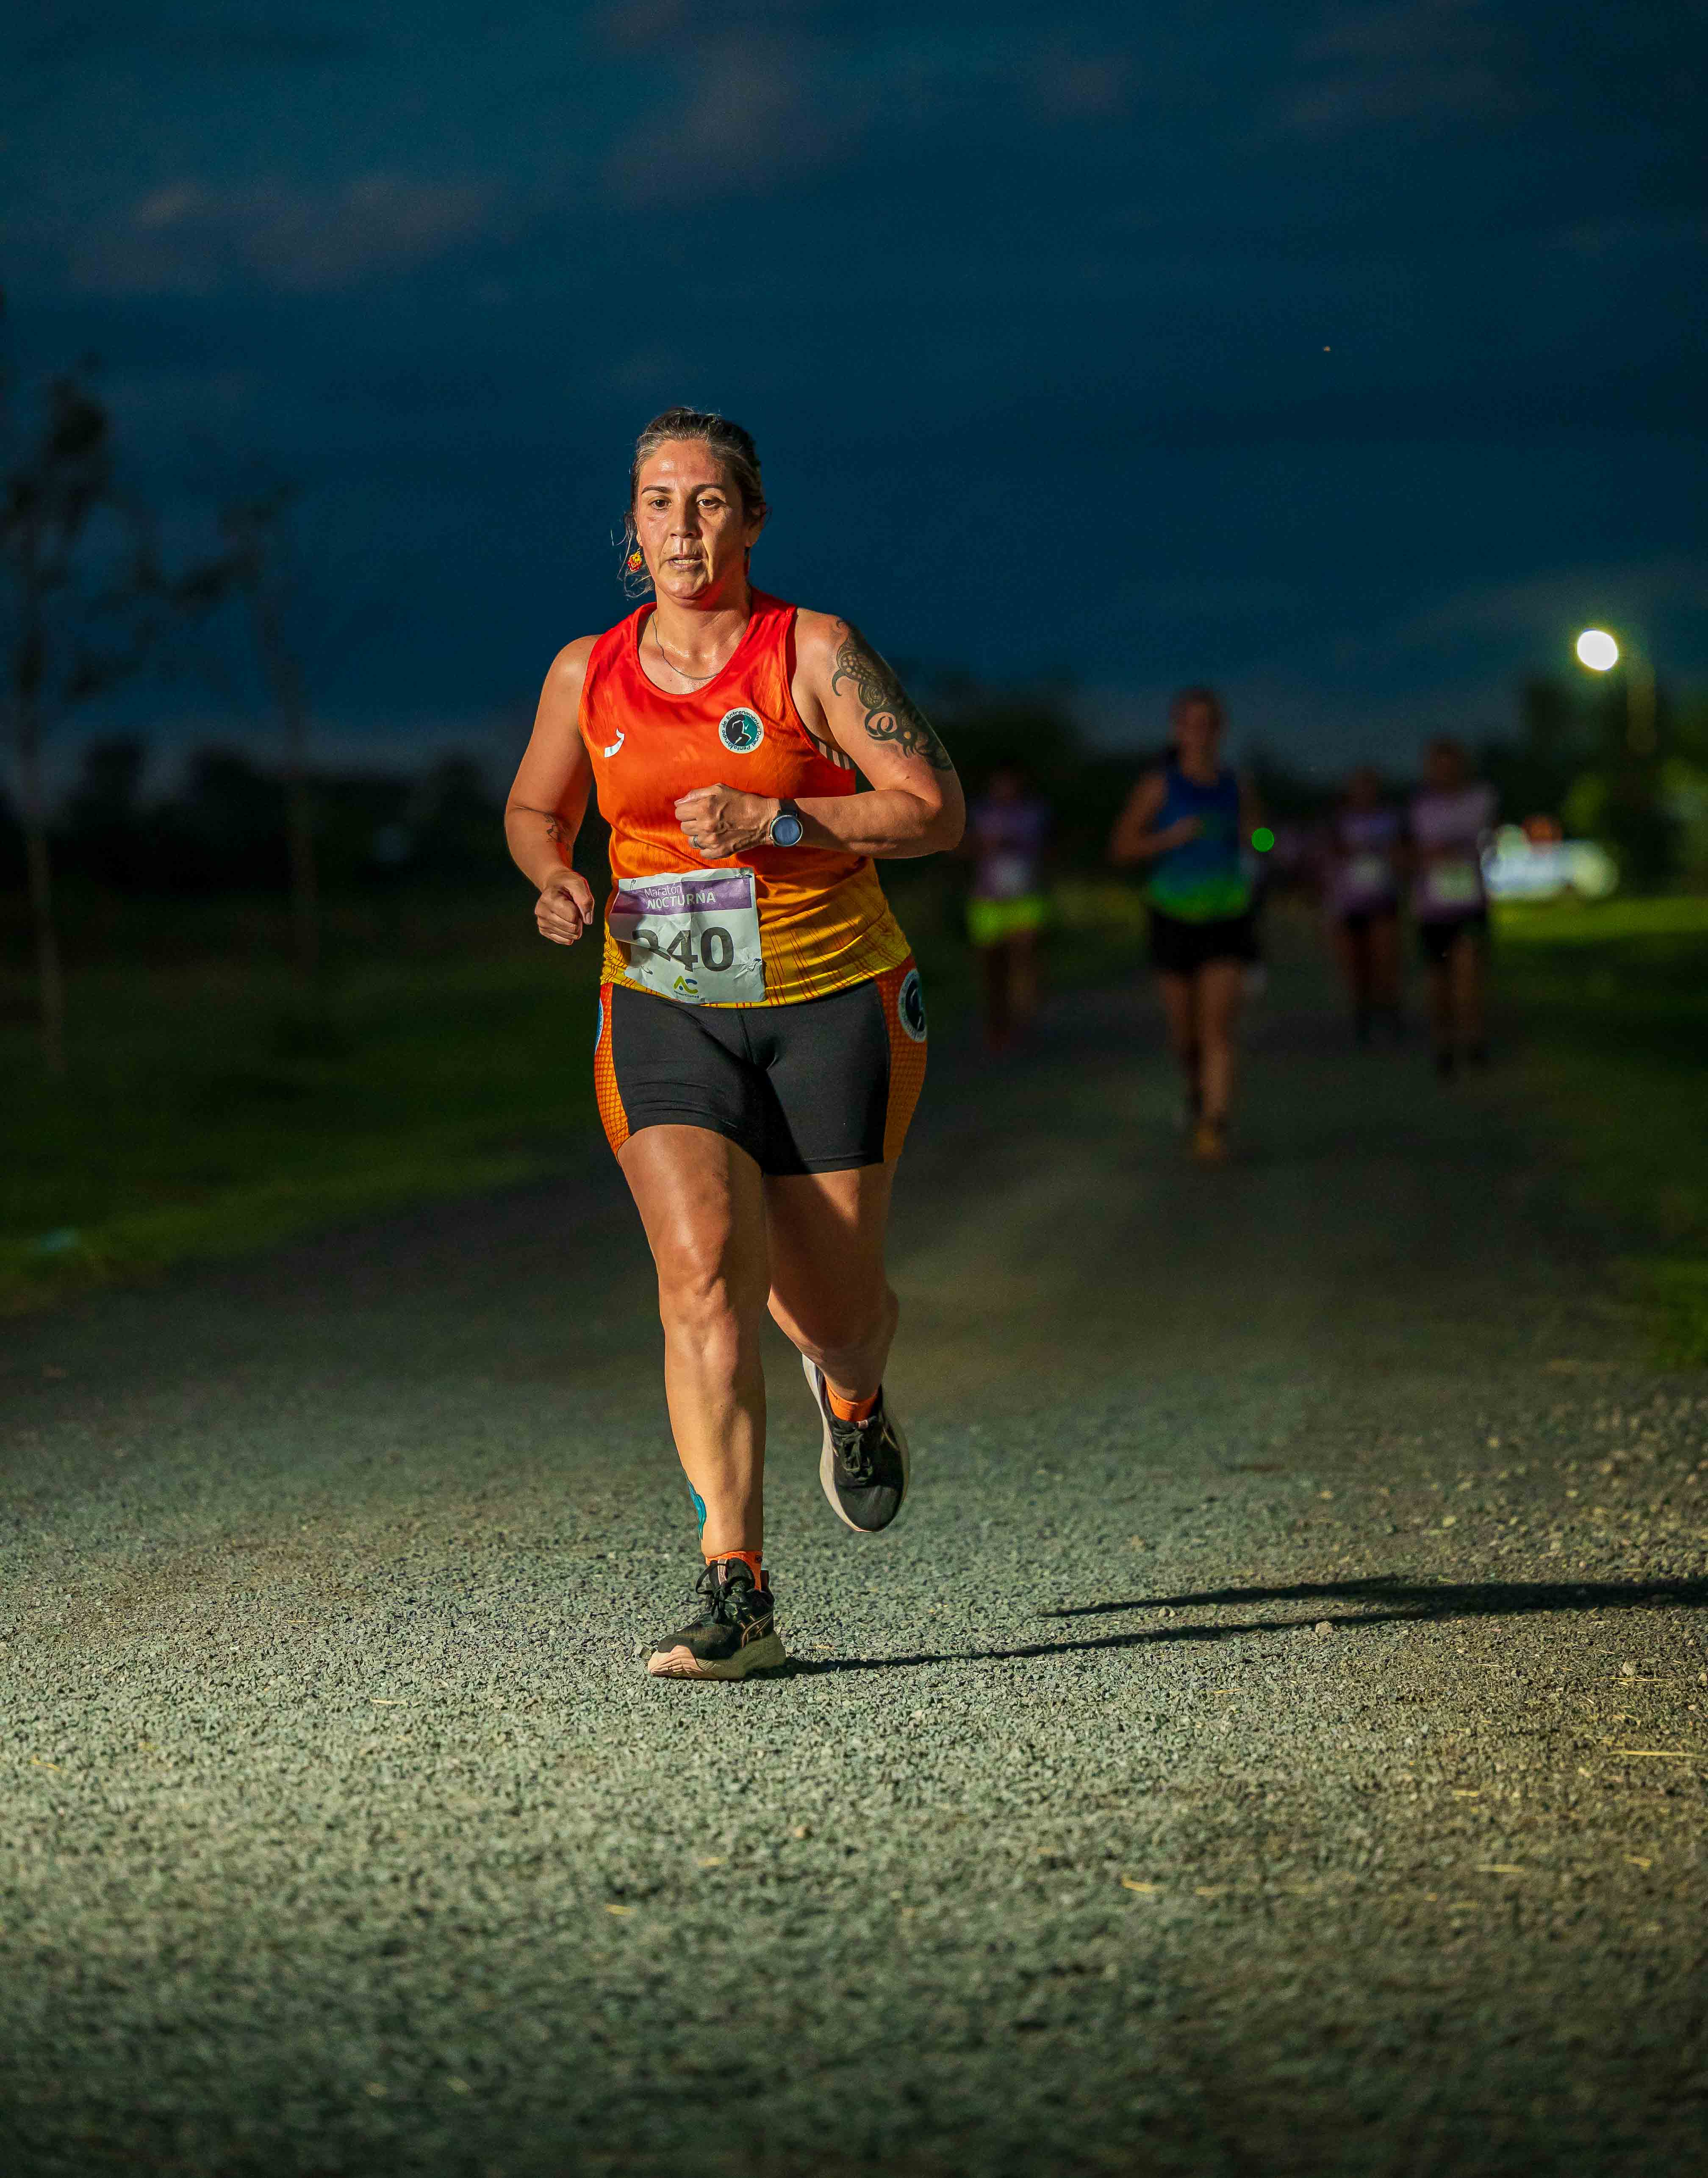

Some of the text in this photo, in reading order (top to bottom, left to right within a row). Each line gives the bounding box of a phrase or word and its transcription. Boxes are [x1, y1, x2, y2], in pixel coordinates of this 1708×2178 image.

[726, 710, 760, 729] Entrenamiento
[722, 730, 732, 746] Grupo
[751, 731, 762, 746] Daniel
[644, 882, 683, 898] Maratón
[646, 891, 717, 909] NOCTURNA
[632, 927, 734, 972] 240
